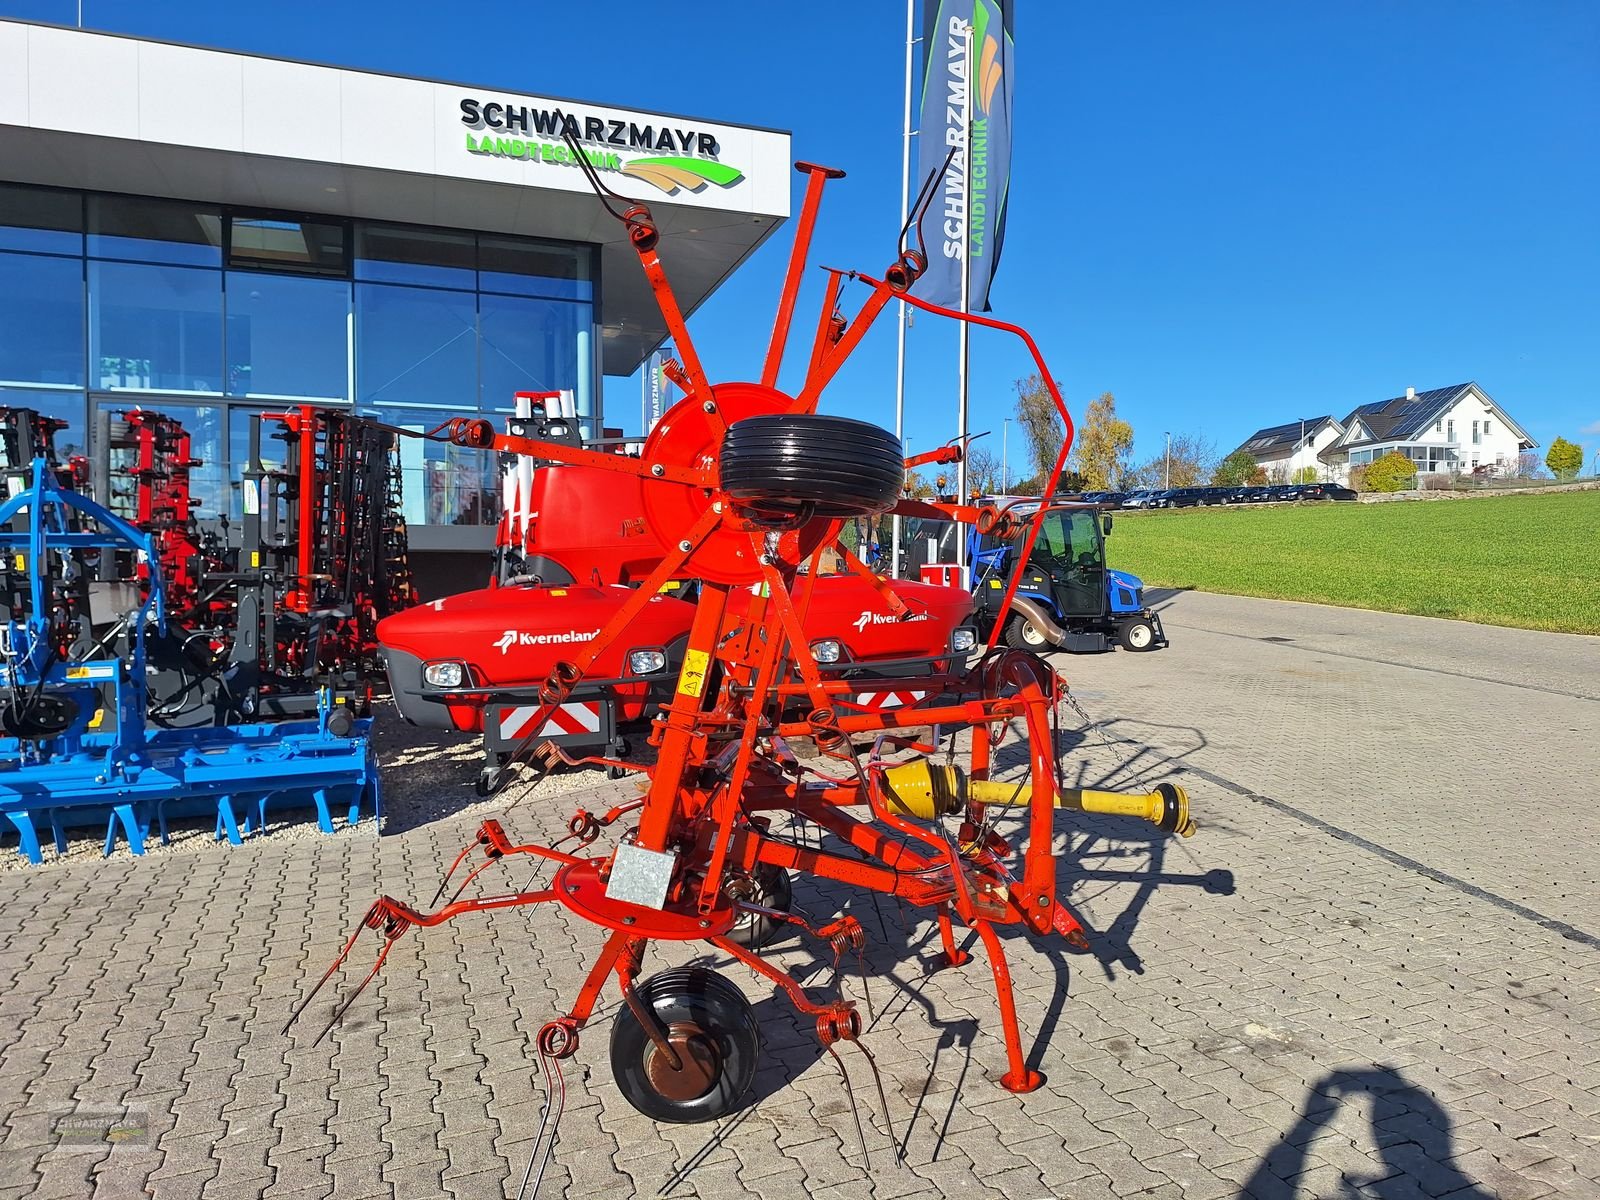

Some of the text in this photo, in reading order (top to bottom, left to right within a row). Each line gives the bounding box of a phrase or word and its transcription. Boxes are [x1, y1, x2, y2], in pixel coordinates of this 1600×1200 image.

[460, 98, 717, 156] SCHWARZMAYR
[943, 16, 968, 260] SCHWARZMAYR
[970, 118, 988, 257] LANDTECHNIK
